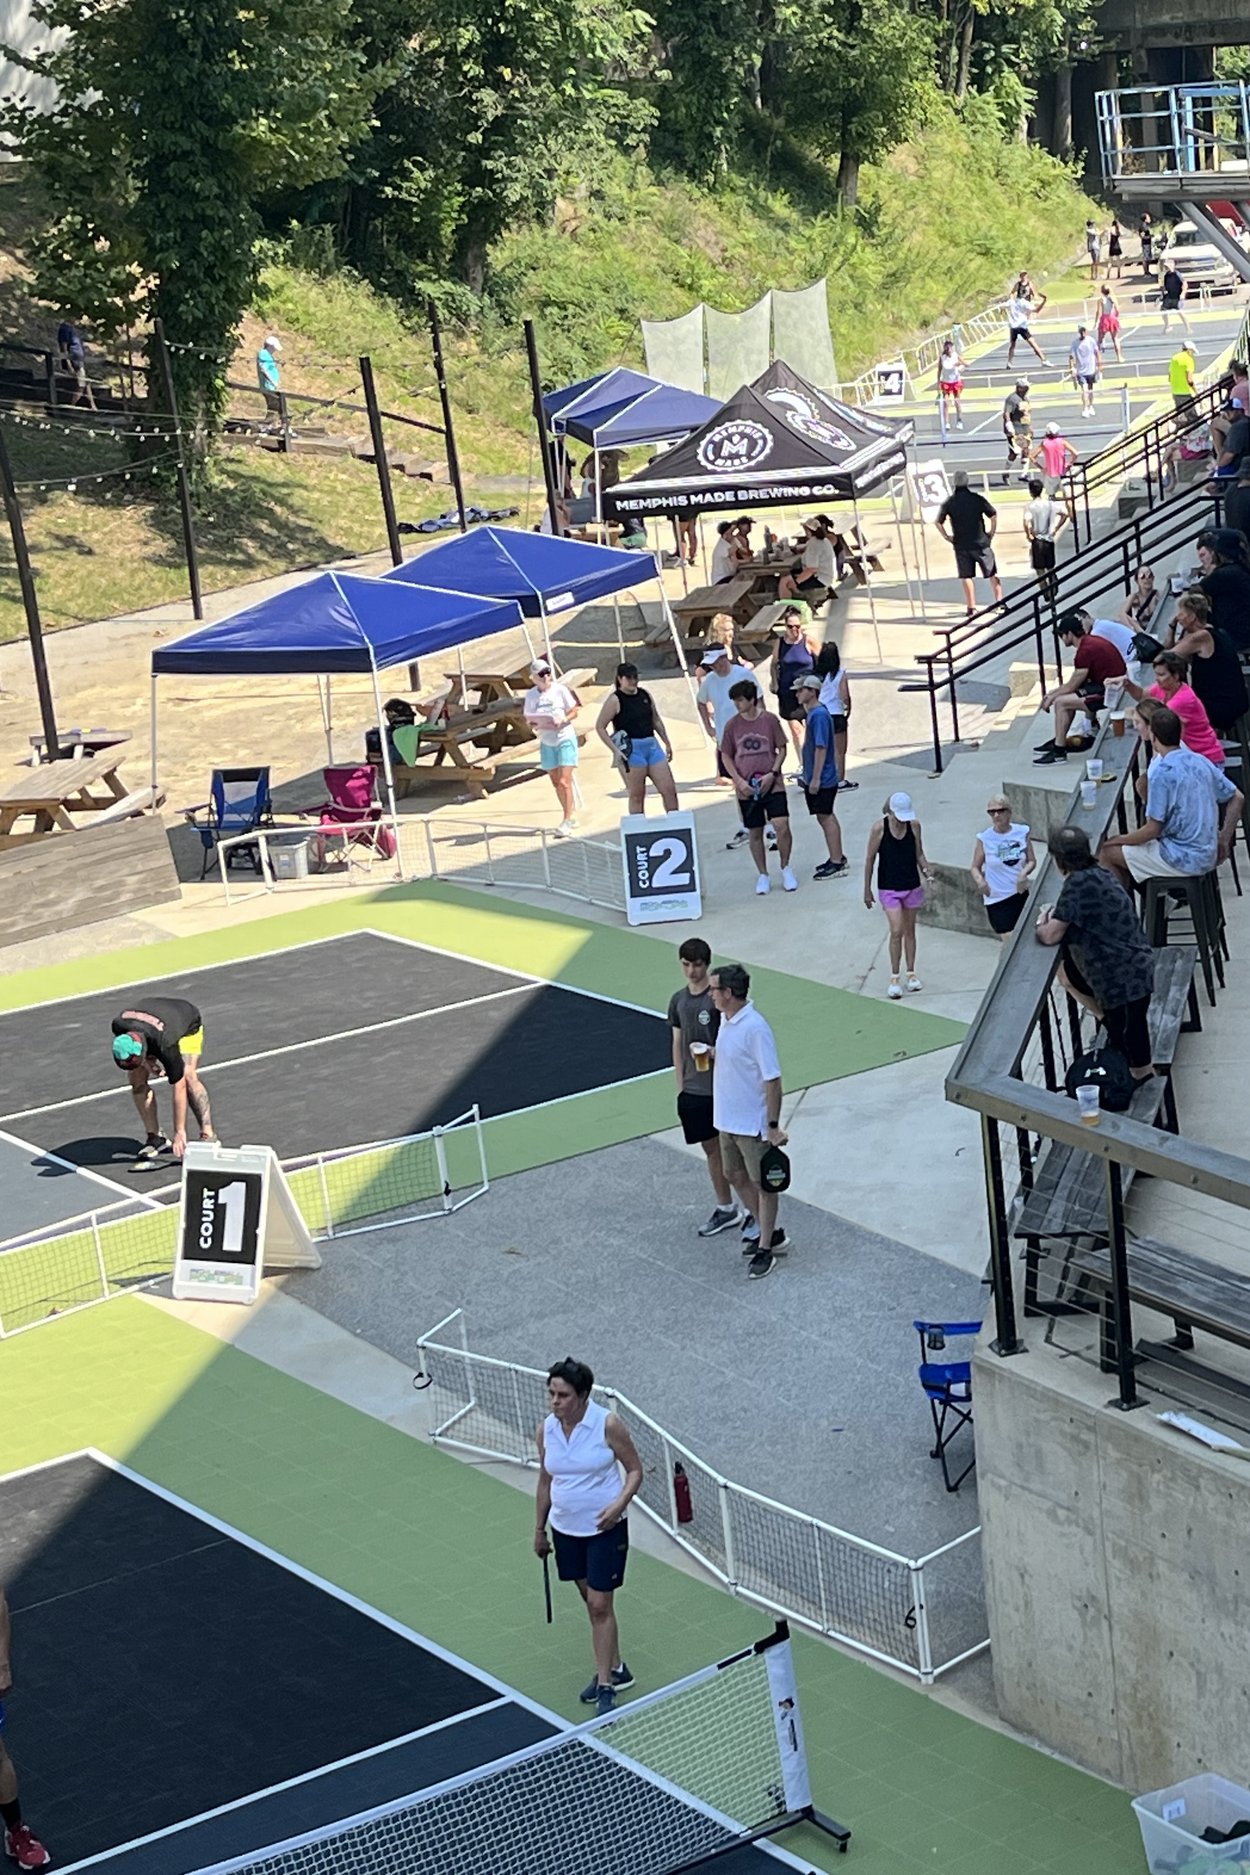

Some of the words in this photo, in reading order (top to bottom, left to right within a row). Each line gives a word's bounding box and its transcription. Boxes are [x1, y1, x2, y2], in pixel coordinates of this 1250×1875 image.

[884, 372, 900, 393] 4
[615, 494, 689, 512] MEMPHIS
[690, 490, 736, 506] MADE
[737, 485, 811, 501] BREWING
[811, 483, 840, 496] CO.
[923, 473, 949, 504] 3
[636, 846, 650, 889] COURT
[649, 837, 691, 888] 2
[199, 1187, 216, 1250] COURT
[217, 1181, 247, 1253] 1
